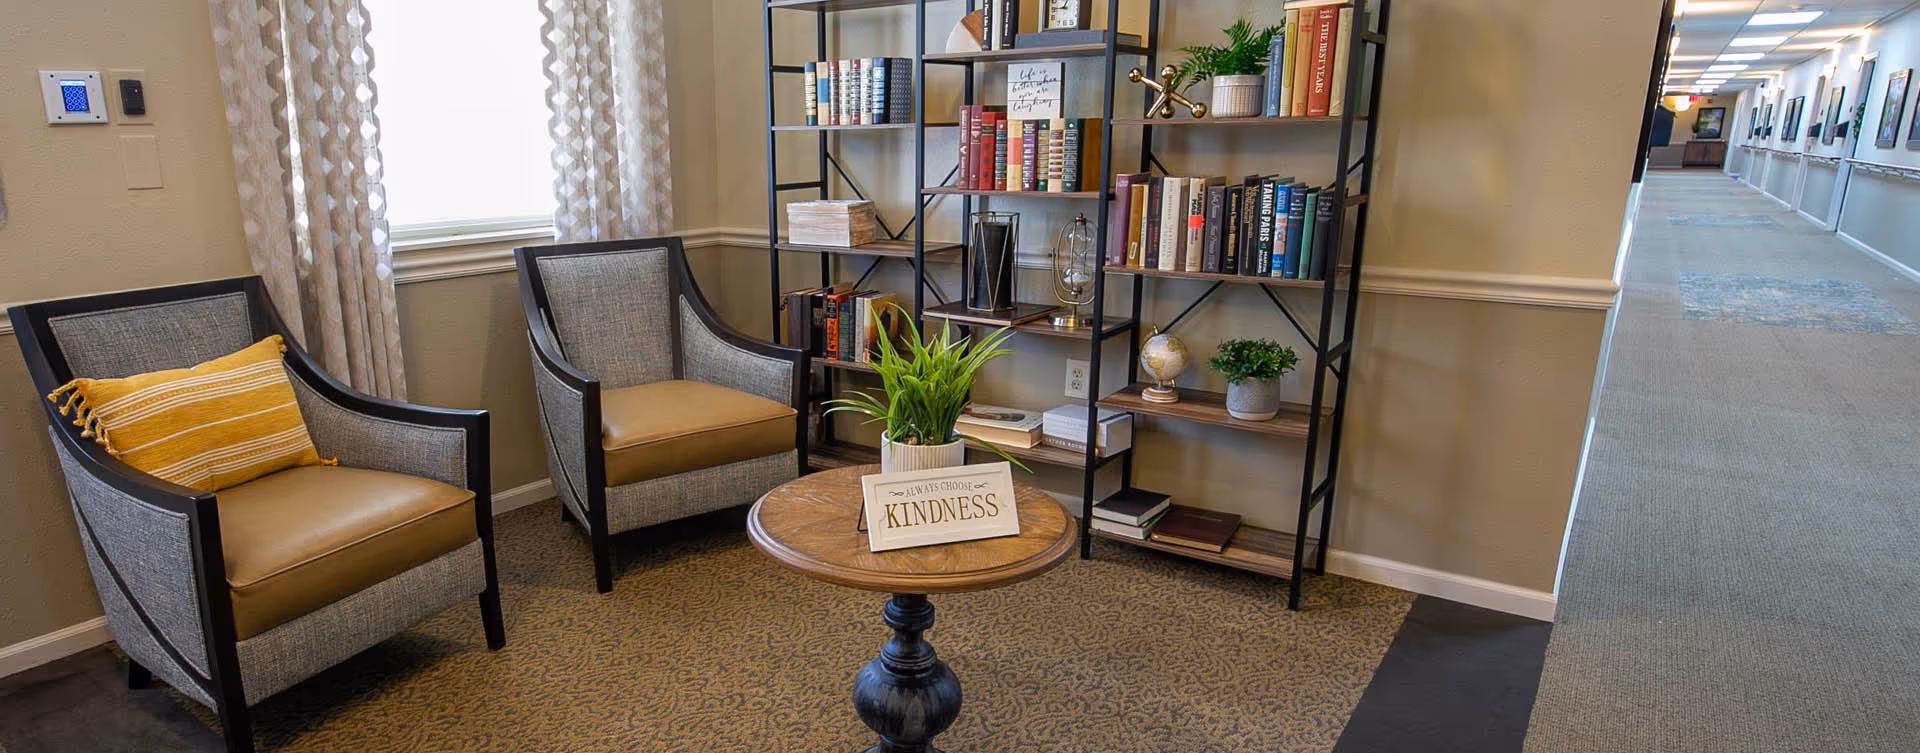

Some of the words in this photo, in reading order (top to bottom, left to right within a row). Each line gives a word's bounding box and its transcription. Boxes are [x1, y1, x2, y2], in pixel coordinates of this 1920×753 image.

[1320, 22, 1329, 42] THE
[1318, 42, 1328, 64] BEST
[1315, 64, 1326, 94] YEARS
[1012, 96, 1053, 112] laughing
[1261, 183, 1274, 215] TAKING
[1260, 215, 1271, 242] PARIS
[905, 482, 940, 498] ALWAYS
[940, 481, 973, 492] CHOOSE
[885, 493, 999, 529] KINDNESS
